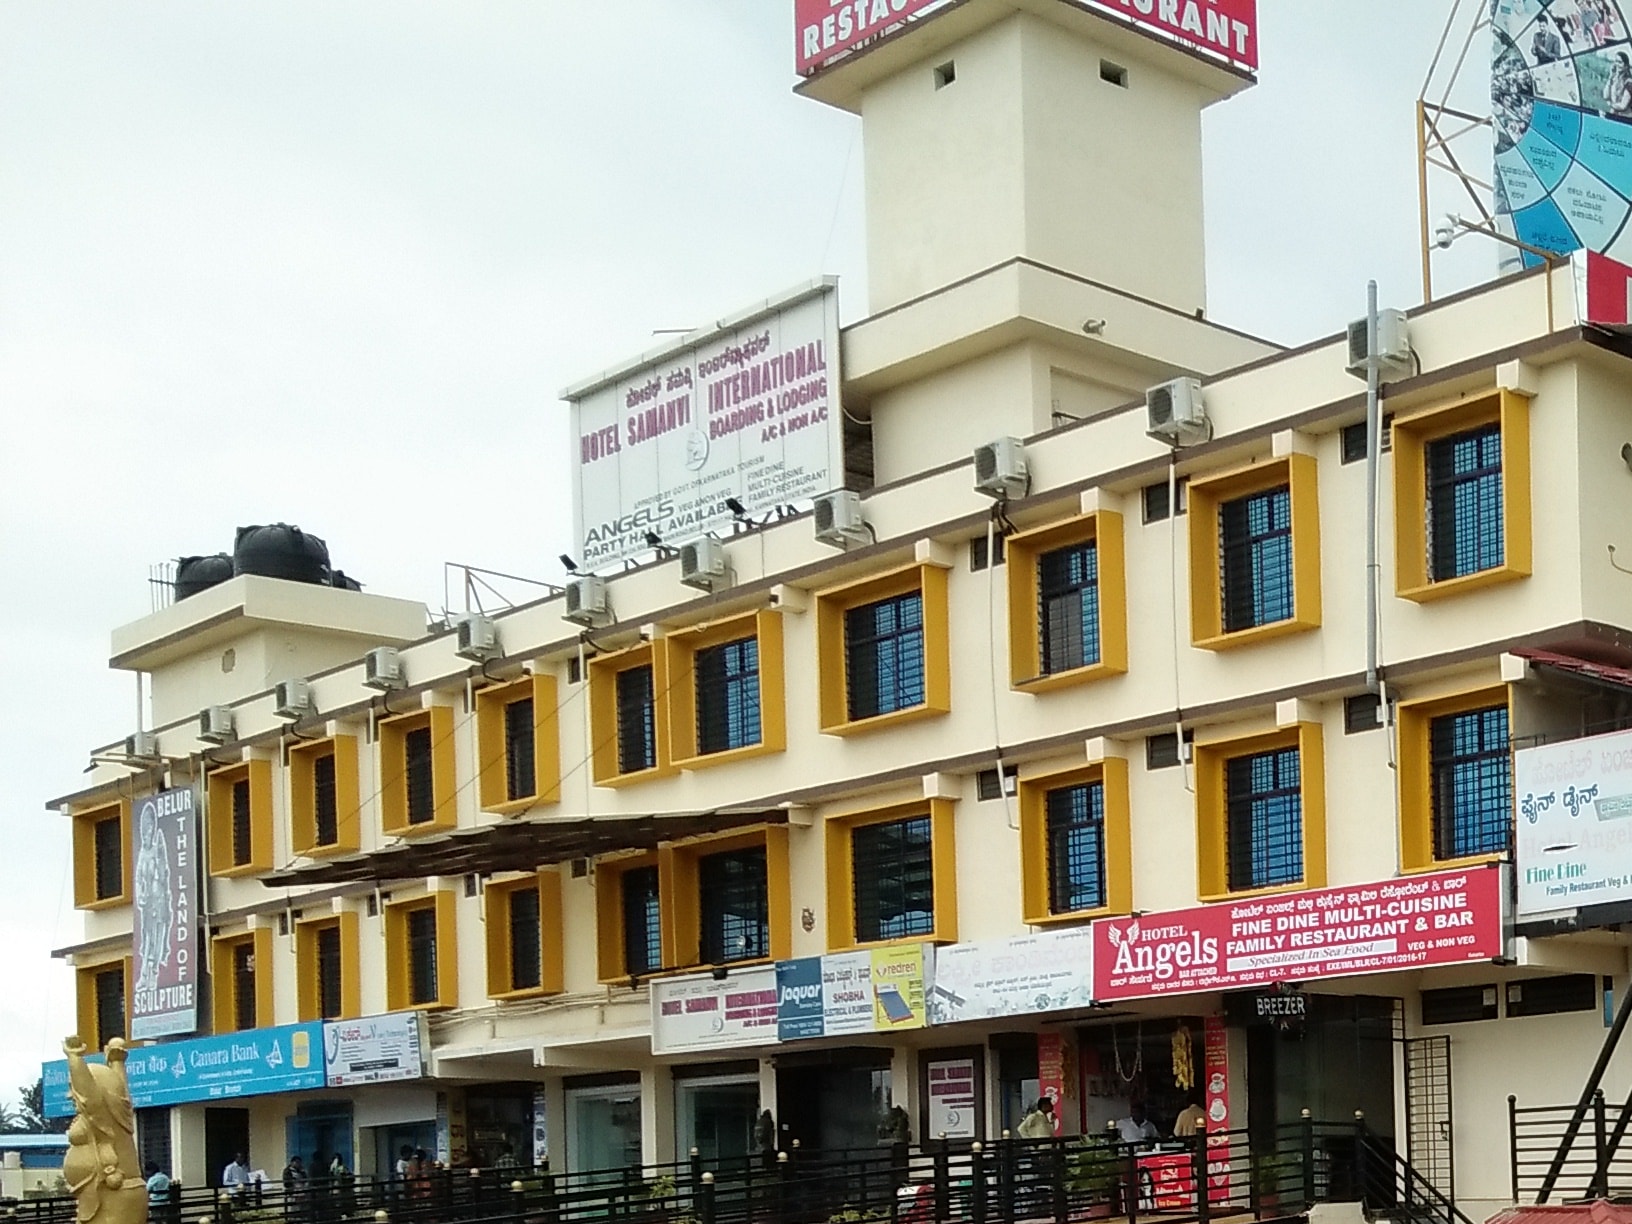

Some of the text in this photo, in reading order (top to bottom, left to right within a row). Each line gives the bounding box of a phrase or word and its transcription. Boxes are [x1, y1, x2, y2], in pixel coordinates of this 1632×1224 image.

[581, 339, 827, 464] HOTEL SAMANVI INTERNATIONAL
[709, 377, 828, 441] BOARDING & LODGING
[779, 422, 786, 437] &
[585, 500, 674, 546] ANGELS
[584, 536, 626, 560] PARTY
[157, 789, 192, 818] BELUR
[1431, 880, 1440, 892] &
[1526, 861, 1587, 884] Fine Dine
[1546, 885, 1568, 896] Family
[1569, 880, 1606, 891] Restaurant
[1608, 876, 1621, 888] Veg
[1623, 875, 1629, 885] &
[176, 817, 188, 982] THE LAND OF
[1232, 892, 1467, 937] FINE DINE MULTI-CUISINE
[1141, 925, 1188, 942] HOTEL
[1226, 911, 1474, 955] FAMILY RESTAURANT & BAR
[1407, 934, 1475, 951] VEG & NON VEG
[1112, 930, 1218, 979] Angels
[1248, 942, 1374, 967] Specialized In Sea Food
[133, 984, 193, 1014] SCULPTURE
[1256, 996, 1305, 1016] BREEZER
[190, 1041, 260, 1068] Canara Bank
